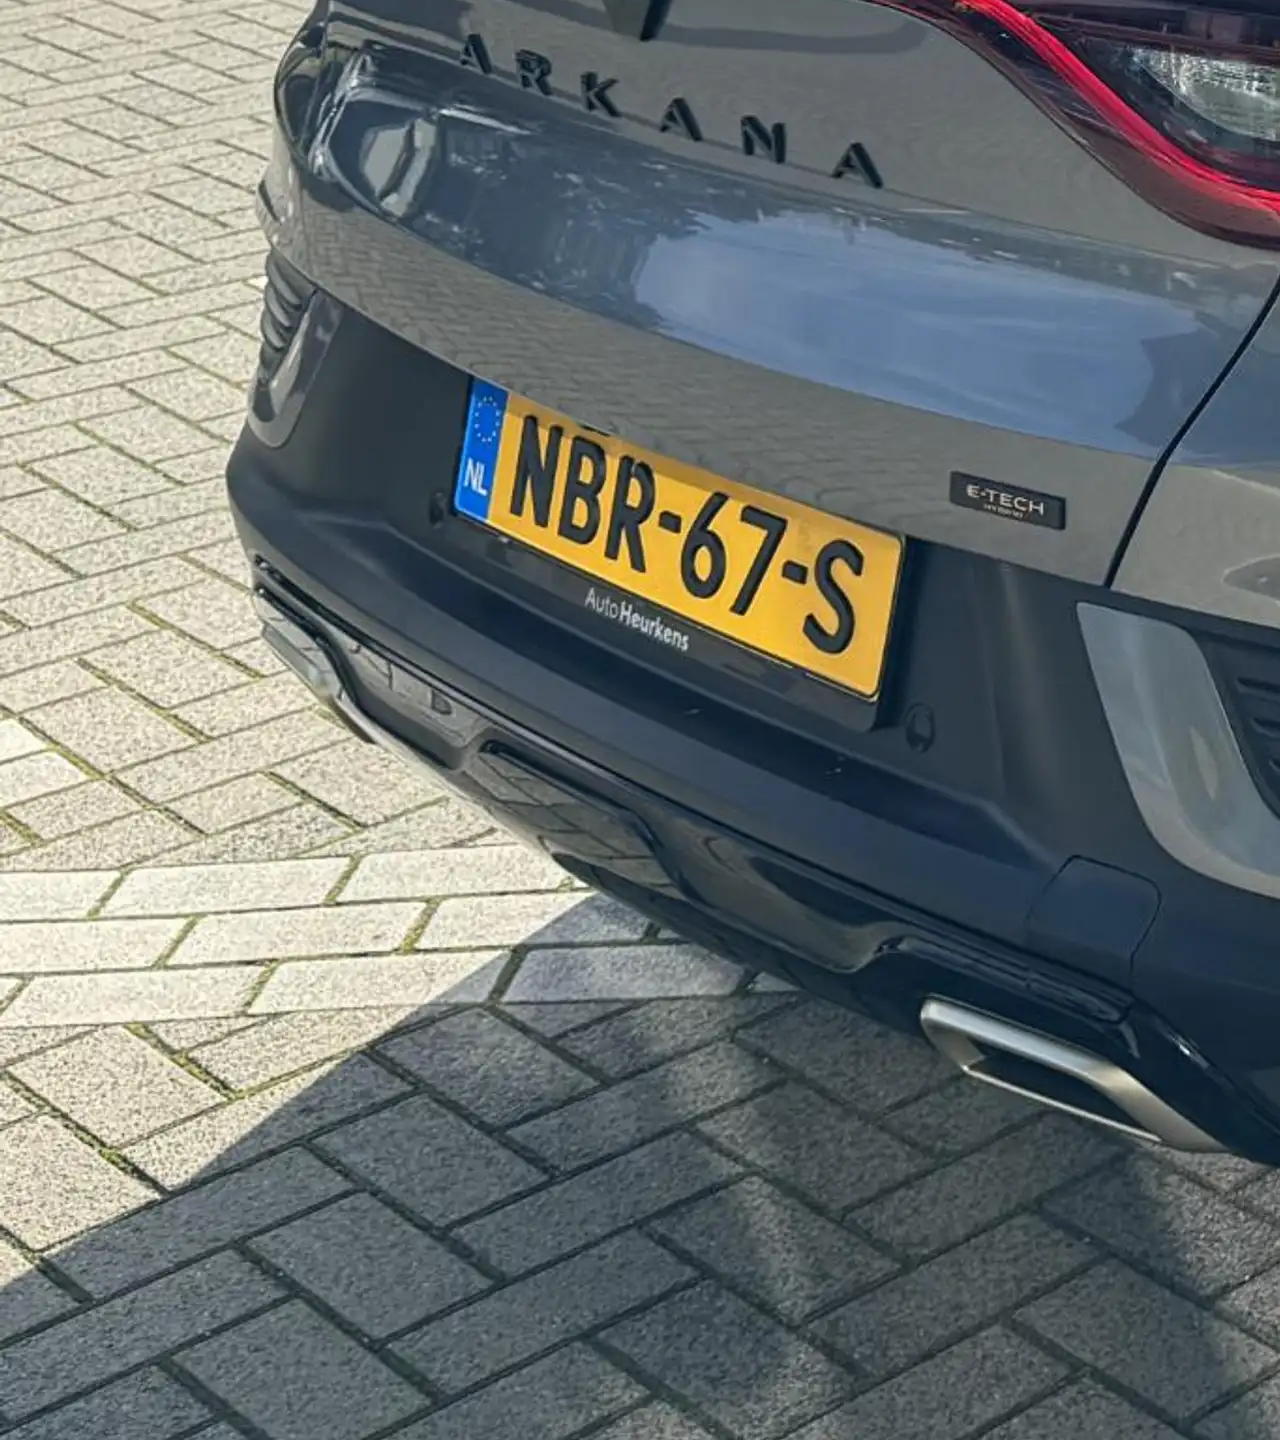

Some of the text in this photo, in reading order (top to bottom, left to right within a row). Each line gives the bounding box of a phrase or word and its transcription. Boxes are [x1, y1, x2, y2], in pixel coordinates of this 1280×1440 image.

[459, 33, 885, 189] ARKANA
[463, 458, 489, 498] NL
[966, 483, 1045, 516] E-TECH
[509, 414, 865, 656] NBR-67-S
